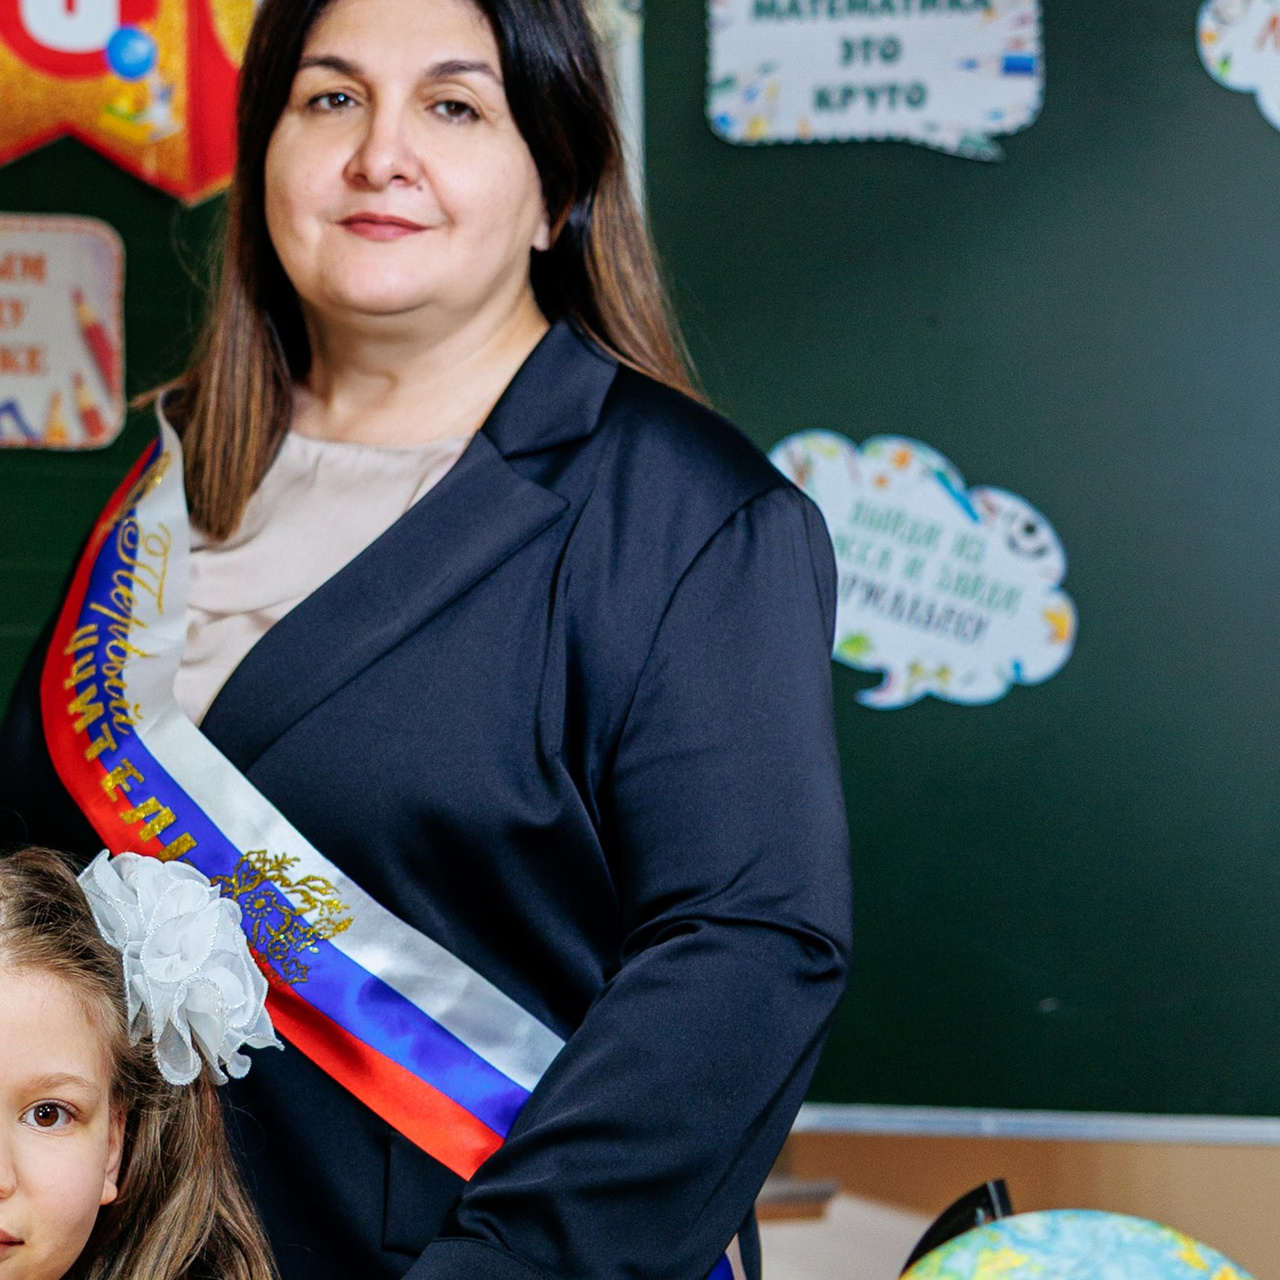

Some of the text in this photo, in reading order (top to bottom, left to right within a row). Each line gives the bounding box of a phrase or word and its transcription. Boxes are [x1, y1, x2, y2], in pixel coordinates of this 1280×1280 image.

[840, 35, 902, 65] ЭТО
[814, 81, 927, 111] КРУТО
[90, 518, 173, 735] Первый
